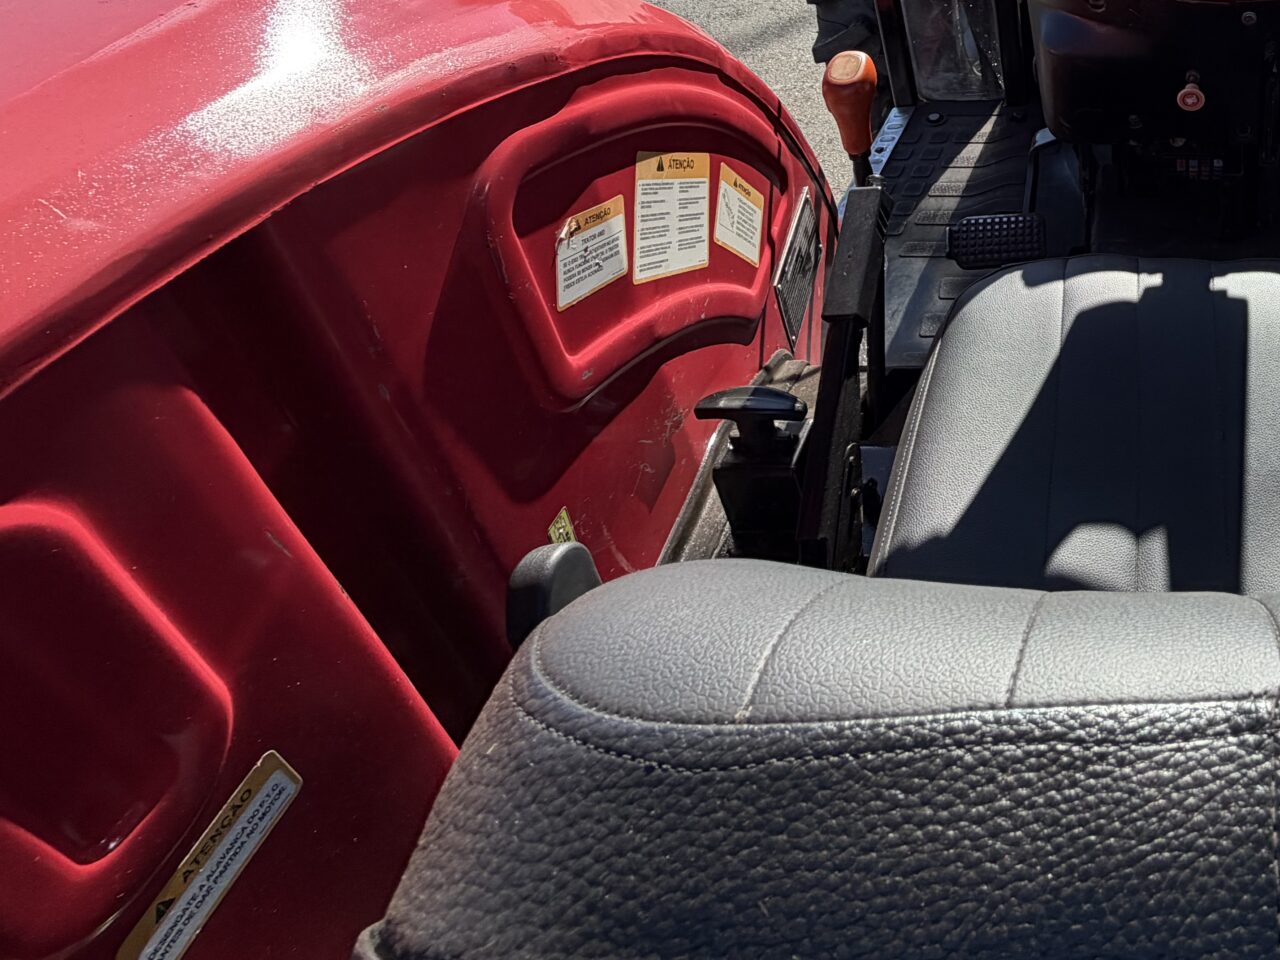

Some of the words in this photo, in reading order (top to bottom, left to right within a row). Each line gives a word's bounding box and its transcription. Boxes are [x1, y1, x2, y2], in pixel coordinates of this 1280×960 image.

[667, 157, 695, 172] ATENÇÃO
[584, 208, 611, 226] ATENÇÃO
[182, 908, 197, 927] DE
[196, 886, 214, 910] DAR
[213, 841, 245, 885] PARTIDA
[246, 824, 260, 843] NO
[258, 786, 287, 826] MOTOR
[183, 788, 252, 883] ATENÇÃO
[206, 826, 248, 883] ALAVANCA
[247, 808, 261, 826] DO
